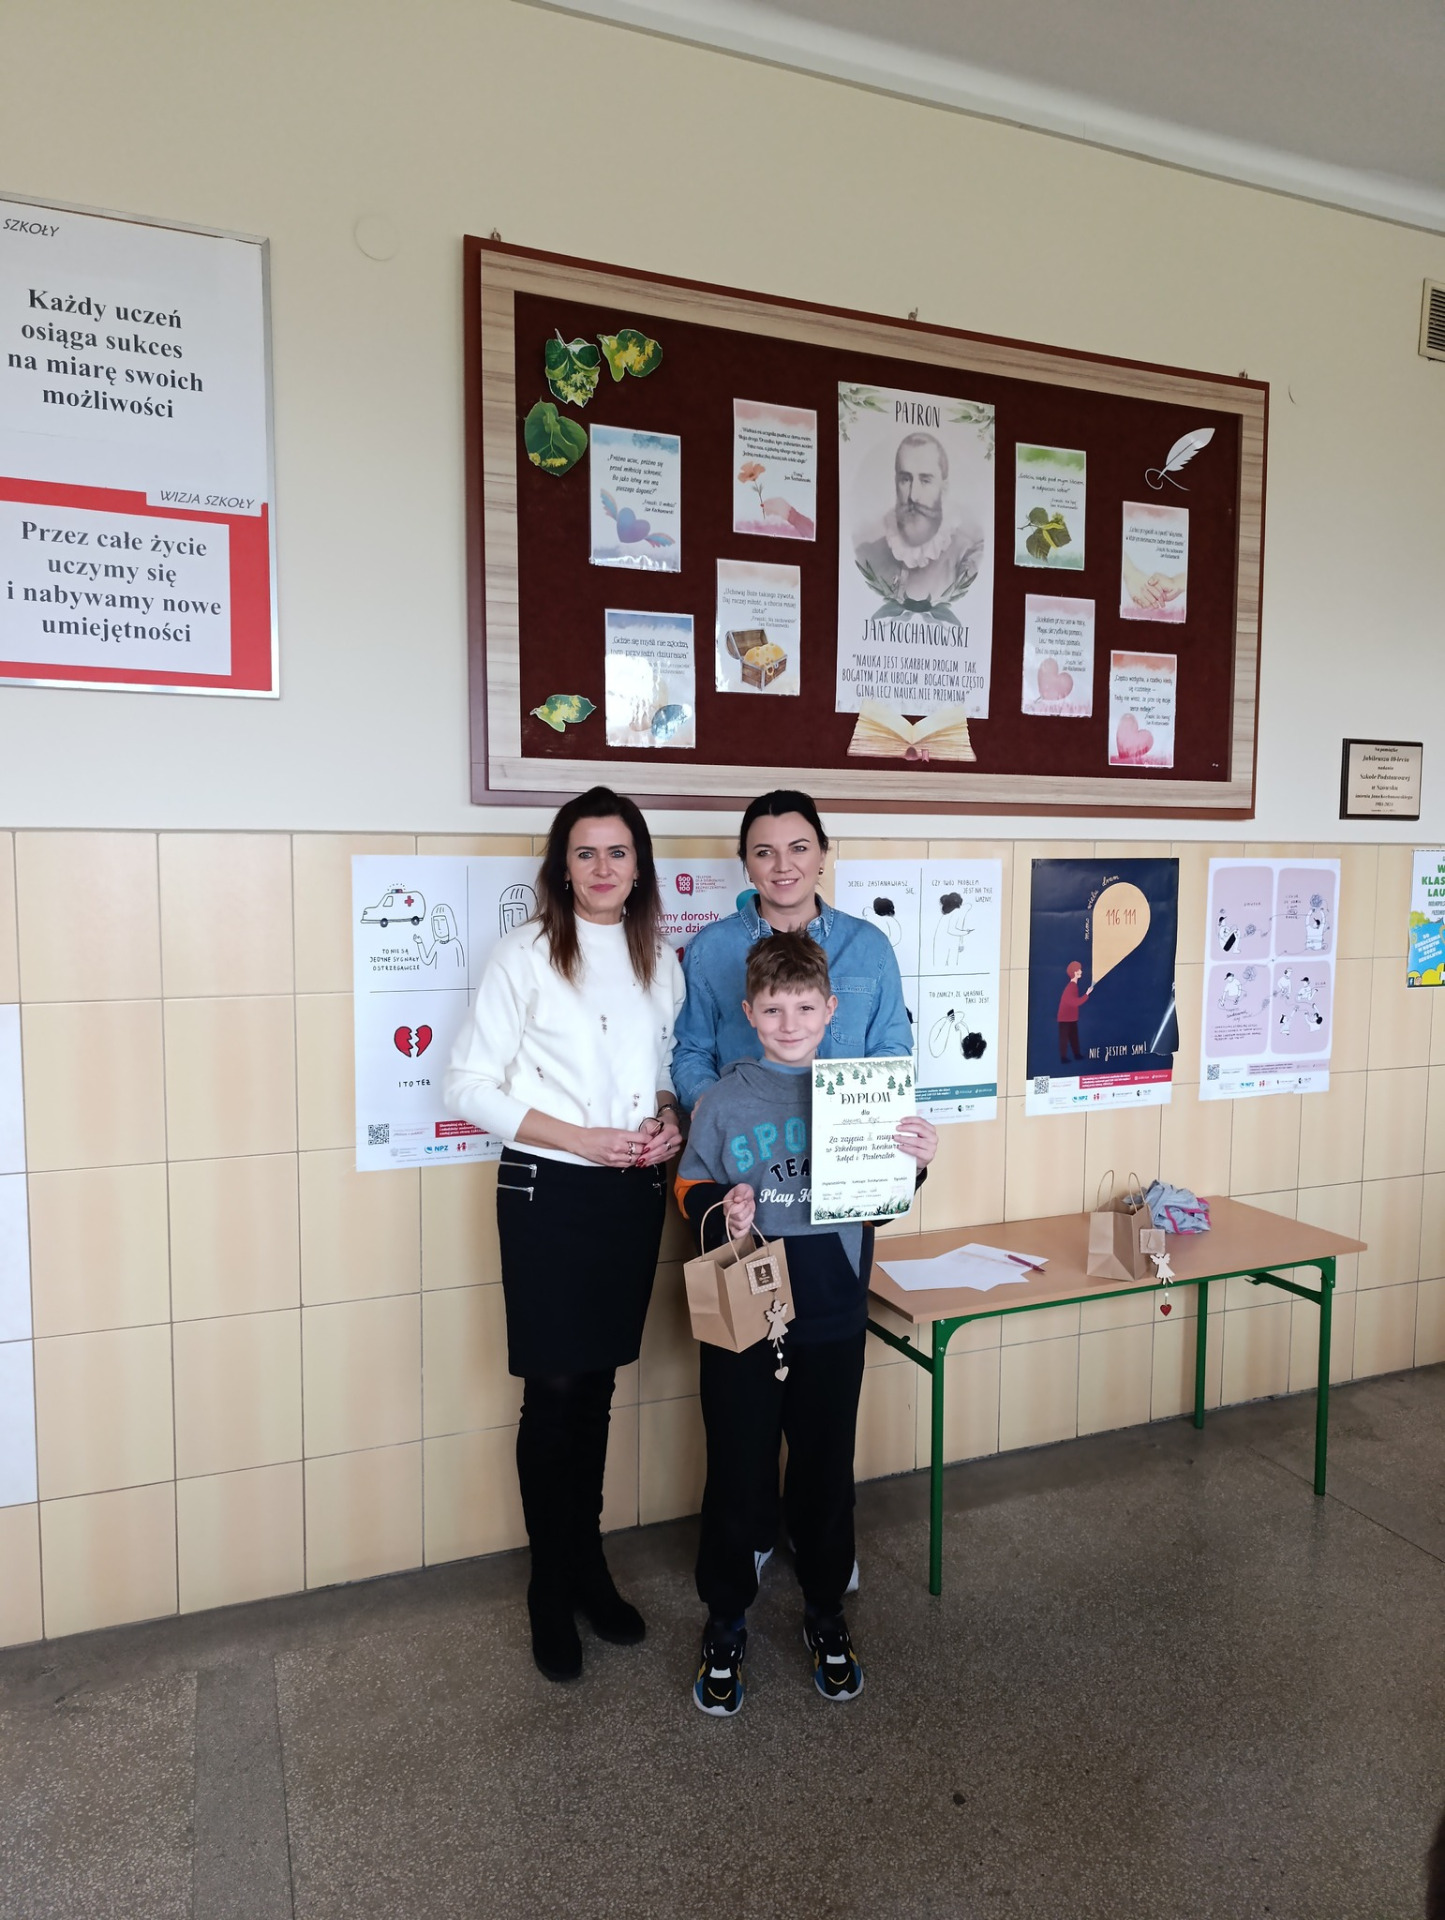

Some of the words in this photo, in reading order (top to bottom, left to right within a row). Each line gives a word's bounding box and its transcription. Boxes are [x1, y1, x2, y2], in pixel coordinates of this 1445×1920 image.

[3, 218, 59, 237] SZKOŁY
[28, 288, 107, 322] Każdy
[115, 309, 182, 329] uczeń
[21, 322, 97, 350] osiąga
[106, 333, 183, 359] sukces
[7, 352, 37, 370] na
[46, 356, 117, 386] miarę
[125, 368, 203, 392] swoich
[42, 387, 174, 418] możliwości
[895, 400, 941, 429] PATRON
[160, 490, 200, 505] WIZJA
[204, 495, 254, 509] SZKOŁY
[21, 520, 89, 546] Przez
[97, 531, 143, 550] całe
[150, 534, 207, 558] życie
[48, 558, 139, 584] uczymy
[147, 565, 177, 587] się
[7, 580, 14, 600] i
[23, 584, 155, 615] nabywamy
[162, 596, 222, 615] nowe
[42, 615, 191, 643] umiejętności
[862, 619, 885, 642] JAN
[890, 621, 969, 648] KOCHANOWSKI
[883, 656, 898, 669] JEST
[900, 657, 930, 671] SKARBEM
[932, 659, 959, 672] DROGIM
[964, 661, 977, 673] TAK
[842, 668, 873, 682] BOGATYM
[875, 670, 889, 683] JAK
[890, 671, 918, 685] UBOGIM
[924, 673, 960, 687] BOGACTWA
[961, 675, 984, 691] CZĘSTO
[856, 684, 874, 699] GINĄ
[877, 686, 892, 699] LECZ
[1105, 909, 1120, 926] 116
[1123, 909, 1137, 925] 111
[1089, 1047, 1100, 1059] NIE
[1104, 1045, 1128, 1062] JESTEM
[1131, 1041, 1147, 1056] SAM!
[840, 1092, 891, 1105] DYPLOM
[434, 1144, 449, 1152] NPZ
[730, 1116, 807, 1173] SPO
[829, 1135, 838, 1145] Za
[834, 1144, 868, 1154] Szkolnym
[769, 1158, 811, 1183] TEA
[836, 1154, 855, 1164] Kolęd
[759, 1188, 795, 1207] Play
